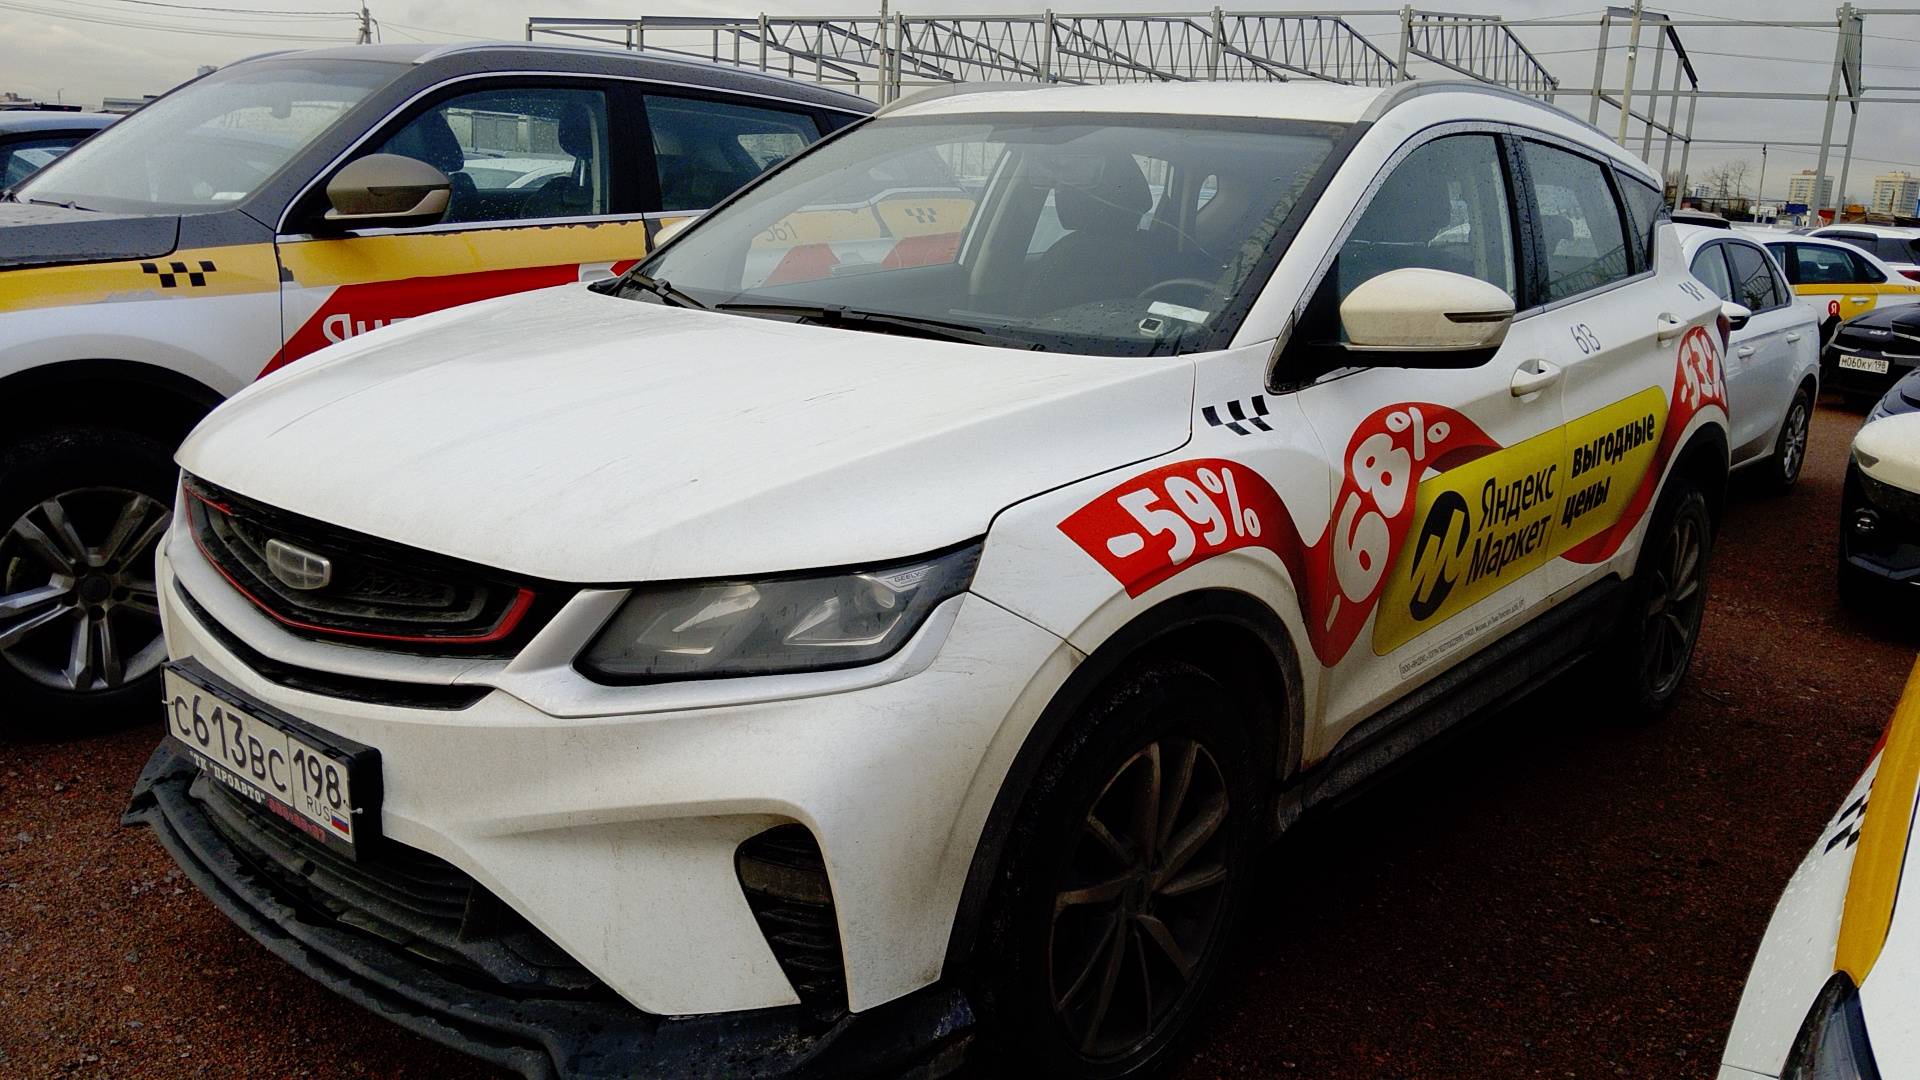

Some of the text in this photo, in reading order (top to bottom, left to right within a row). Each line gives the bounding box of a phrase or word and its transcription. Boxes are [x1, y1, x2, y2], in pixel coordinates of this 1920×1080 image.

[1570, 323, 1601, 355] 613
[1571, 413, 1655, 480] выгодные
[1106, 467, 1262, 566] -59%
[1326, 407, 1450, 632] -68%
[1479, 464, 1557, 532] Яндекс
[1561, 476, 1611, 529] цены
[1466, 515, 1551, 586] Маркет
[293, 748, 342, 810] 198
[306, 795, 331, 822] RUS
